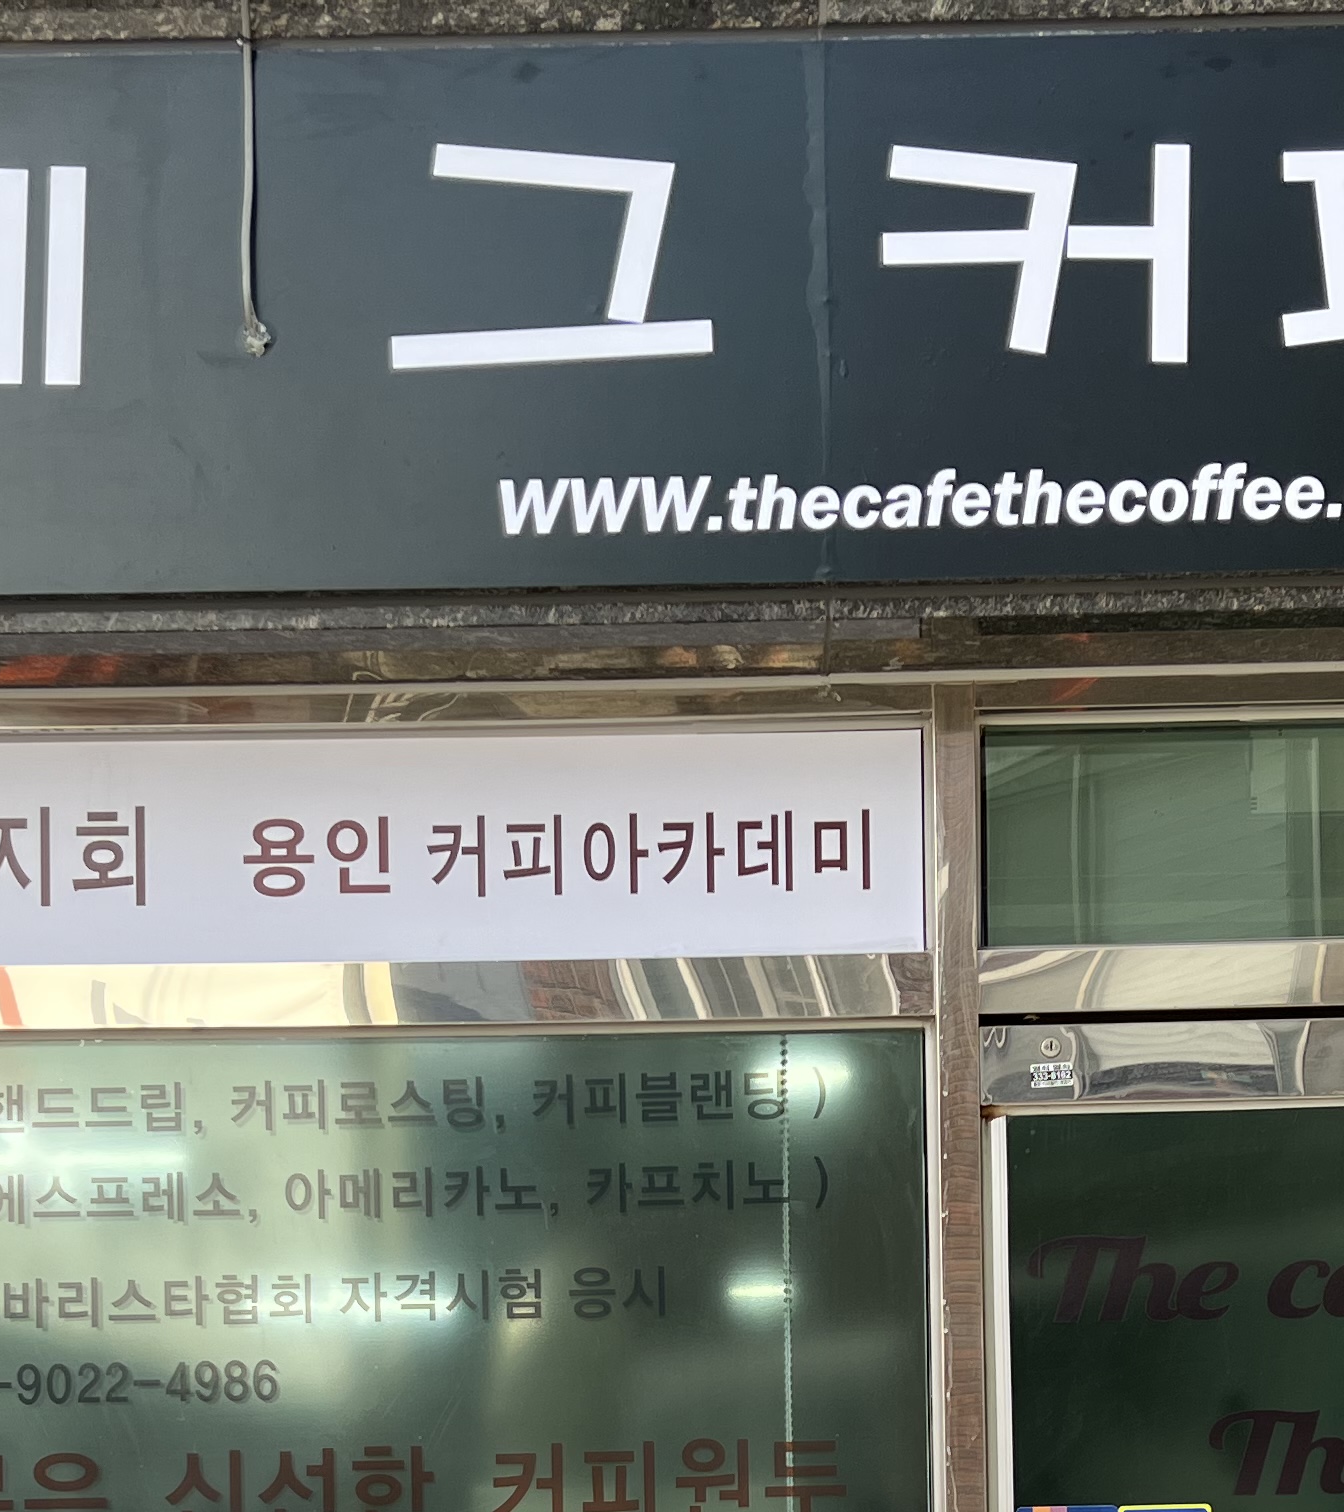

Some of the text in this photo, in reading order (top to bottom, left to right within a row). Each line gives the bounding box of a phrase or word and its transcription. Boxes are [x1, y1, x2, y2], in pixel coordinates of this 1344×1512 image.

[391, 143, 713, 371] 그
[243, 815, 393, 897] 용인
[427, 808, 873, 898] 커피아카데미
[230, 1074, 506, 1134] 커피로스팅,
[532, 1067, 786, 1126] 커피블랜딩
[284, 1163, 561, 1220] 아메리카노,
[585, 1159, 791, 1212] 카프치노
[338, 1265, 545, 1322] 자격시험
[567, 1264, 668, 1321] 응시
[1027, 1234, 1240, 1324] The
